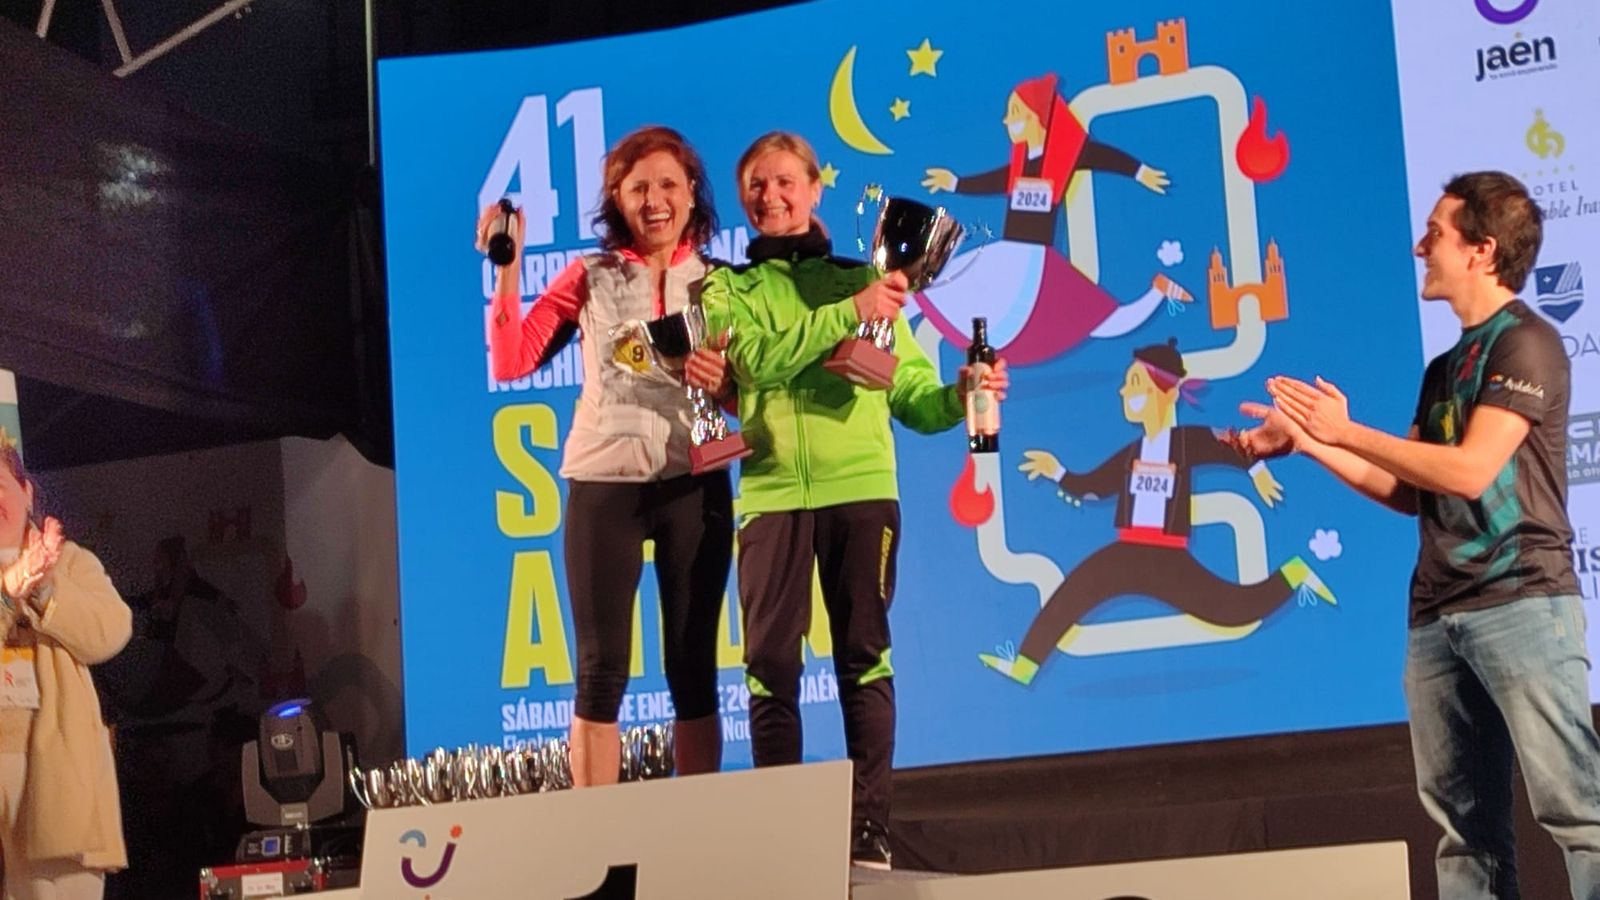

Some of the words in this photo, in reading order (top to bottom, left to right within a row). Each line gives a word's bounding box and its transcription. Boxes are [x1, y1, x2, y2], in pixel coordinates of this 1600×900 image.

[477, 87, 608, 247] 41
[1533, 179, 1579, 196] OTEL
[1016, 191, 1048, 207] 2024
[1136, 475, 1169, 493] 2024
[501, 697, 574, 732] SÁBAD
[637, 690, 677, 720] ENE
